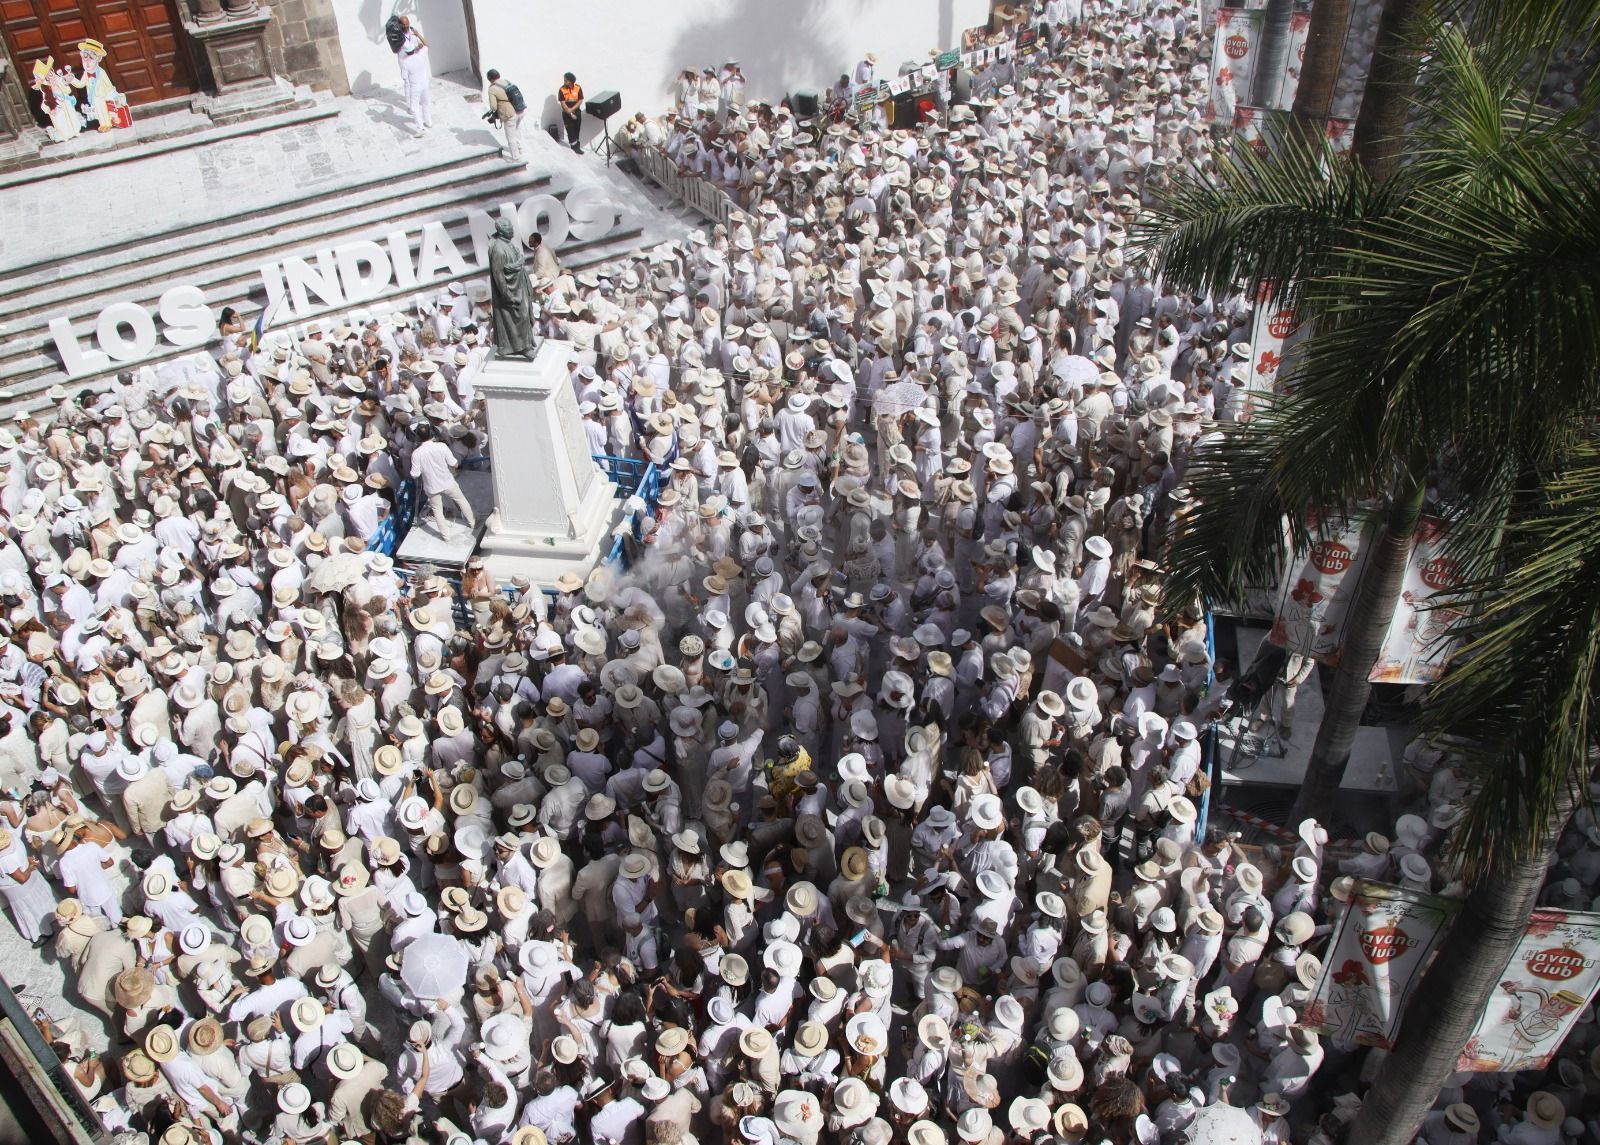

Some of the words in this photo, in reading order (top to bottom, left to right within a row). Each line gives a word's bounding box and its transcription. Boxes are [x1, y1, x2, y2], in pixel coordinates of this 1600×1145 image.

[1226, 46, 1244, 56] Club
[49, 285, 216, 376] LOS
[259, 183, 615, 321] INDIANOS
[1314, 554, 1344, 570] Club
[1353, 922, 1419, 949] Havana
[1362, 943, 1397, 958] Club
[1522, 949, 1596, 968] Havana
[1531, 962, 1573, 978] Club
